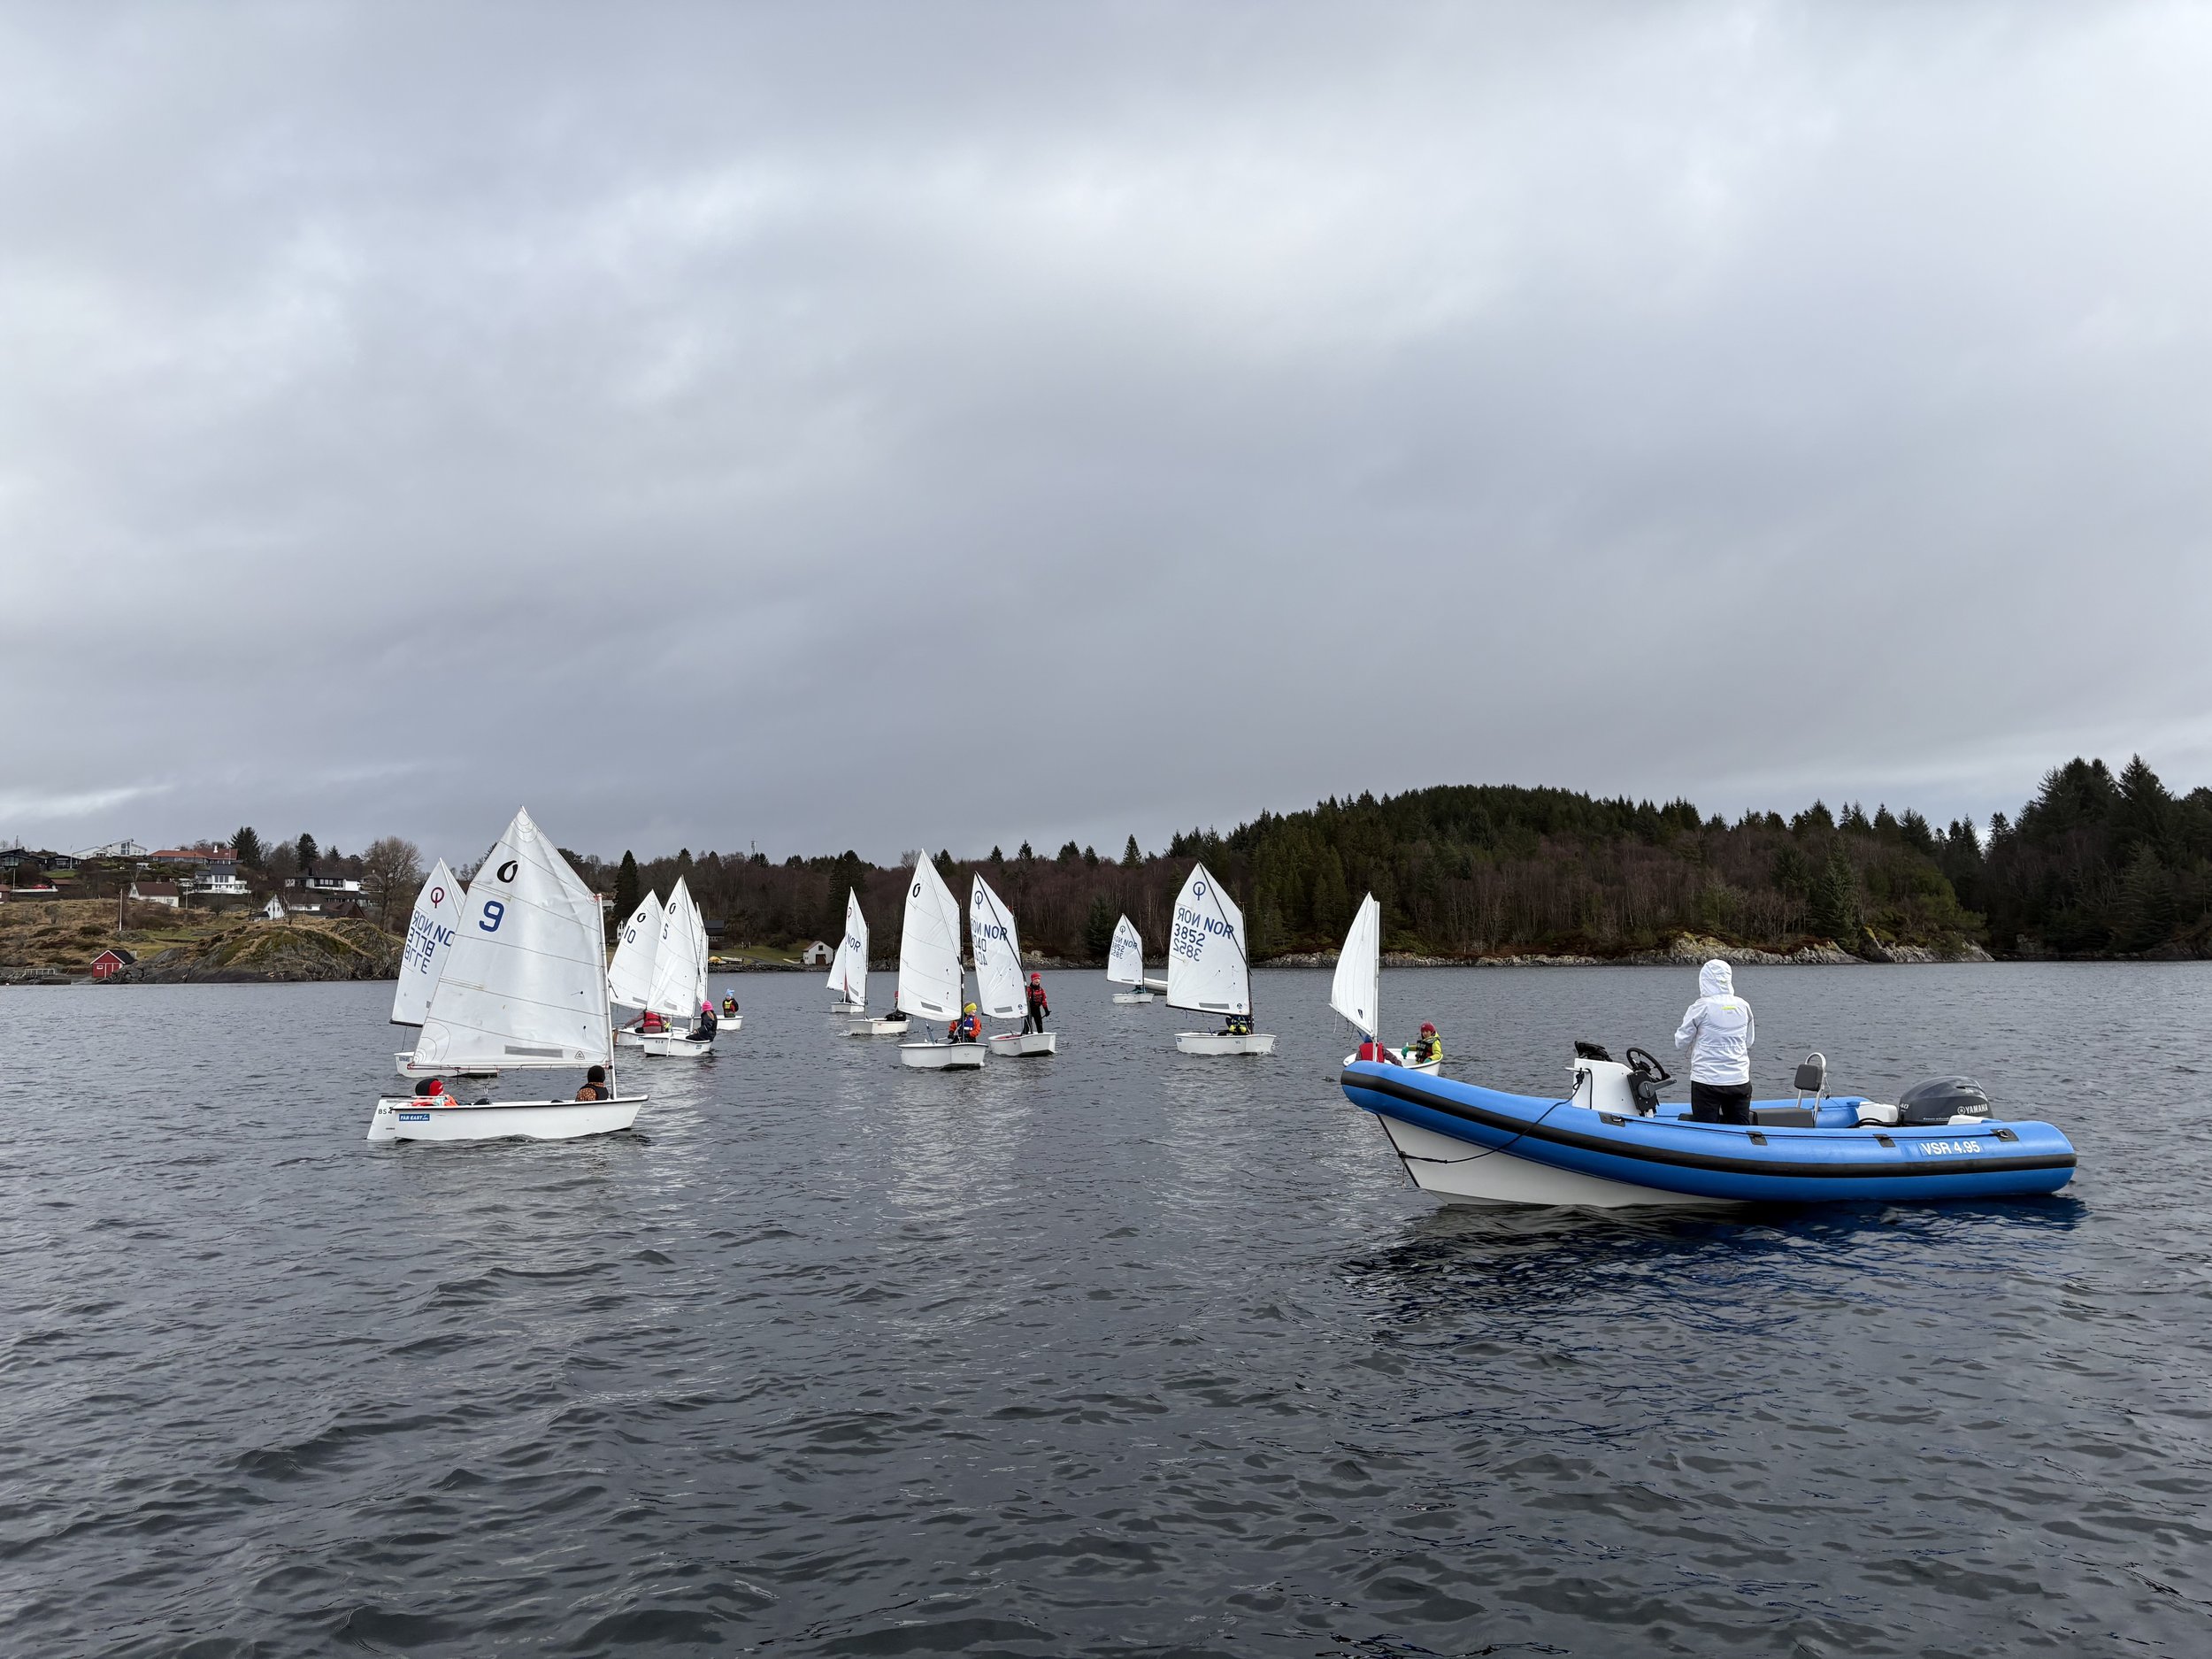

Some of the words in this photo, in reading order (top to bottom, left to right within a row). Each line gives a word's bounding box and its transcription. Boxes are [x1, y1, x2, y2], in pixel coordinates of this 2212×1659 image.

[479, 900, 504, 933] 9
[434, 925, 456, 947] NO
[624, 926, 636, 944] 10
[984, 924, 1008, 941] NOR
[1174, 923, 1205, 947] 3852
[1203, 917, 1234, 940] NOR
[848, 933, 861, 953] NOR
[1123, 939, 1138, 949] NOR
[1965, 1103, 1988, 1114] YAMAHA
[1920, 1141, 1952, 1156] VSR
[1954, 1140, 1980, 1154] 4.95
